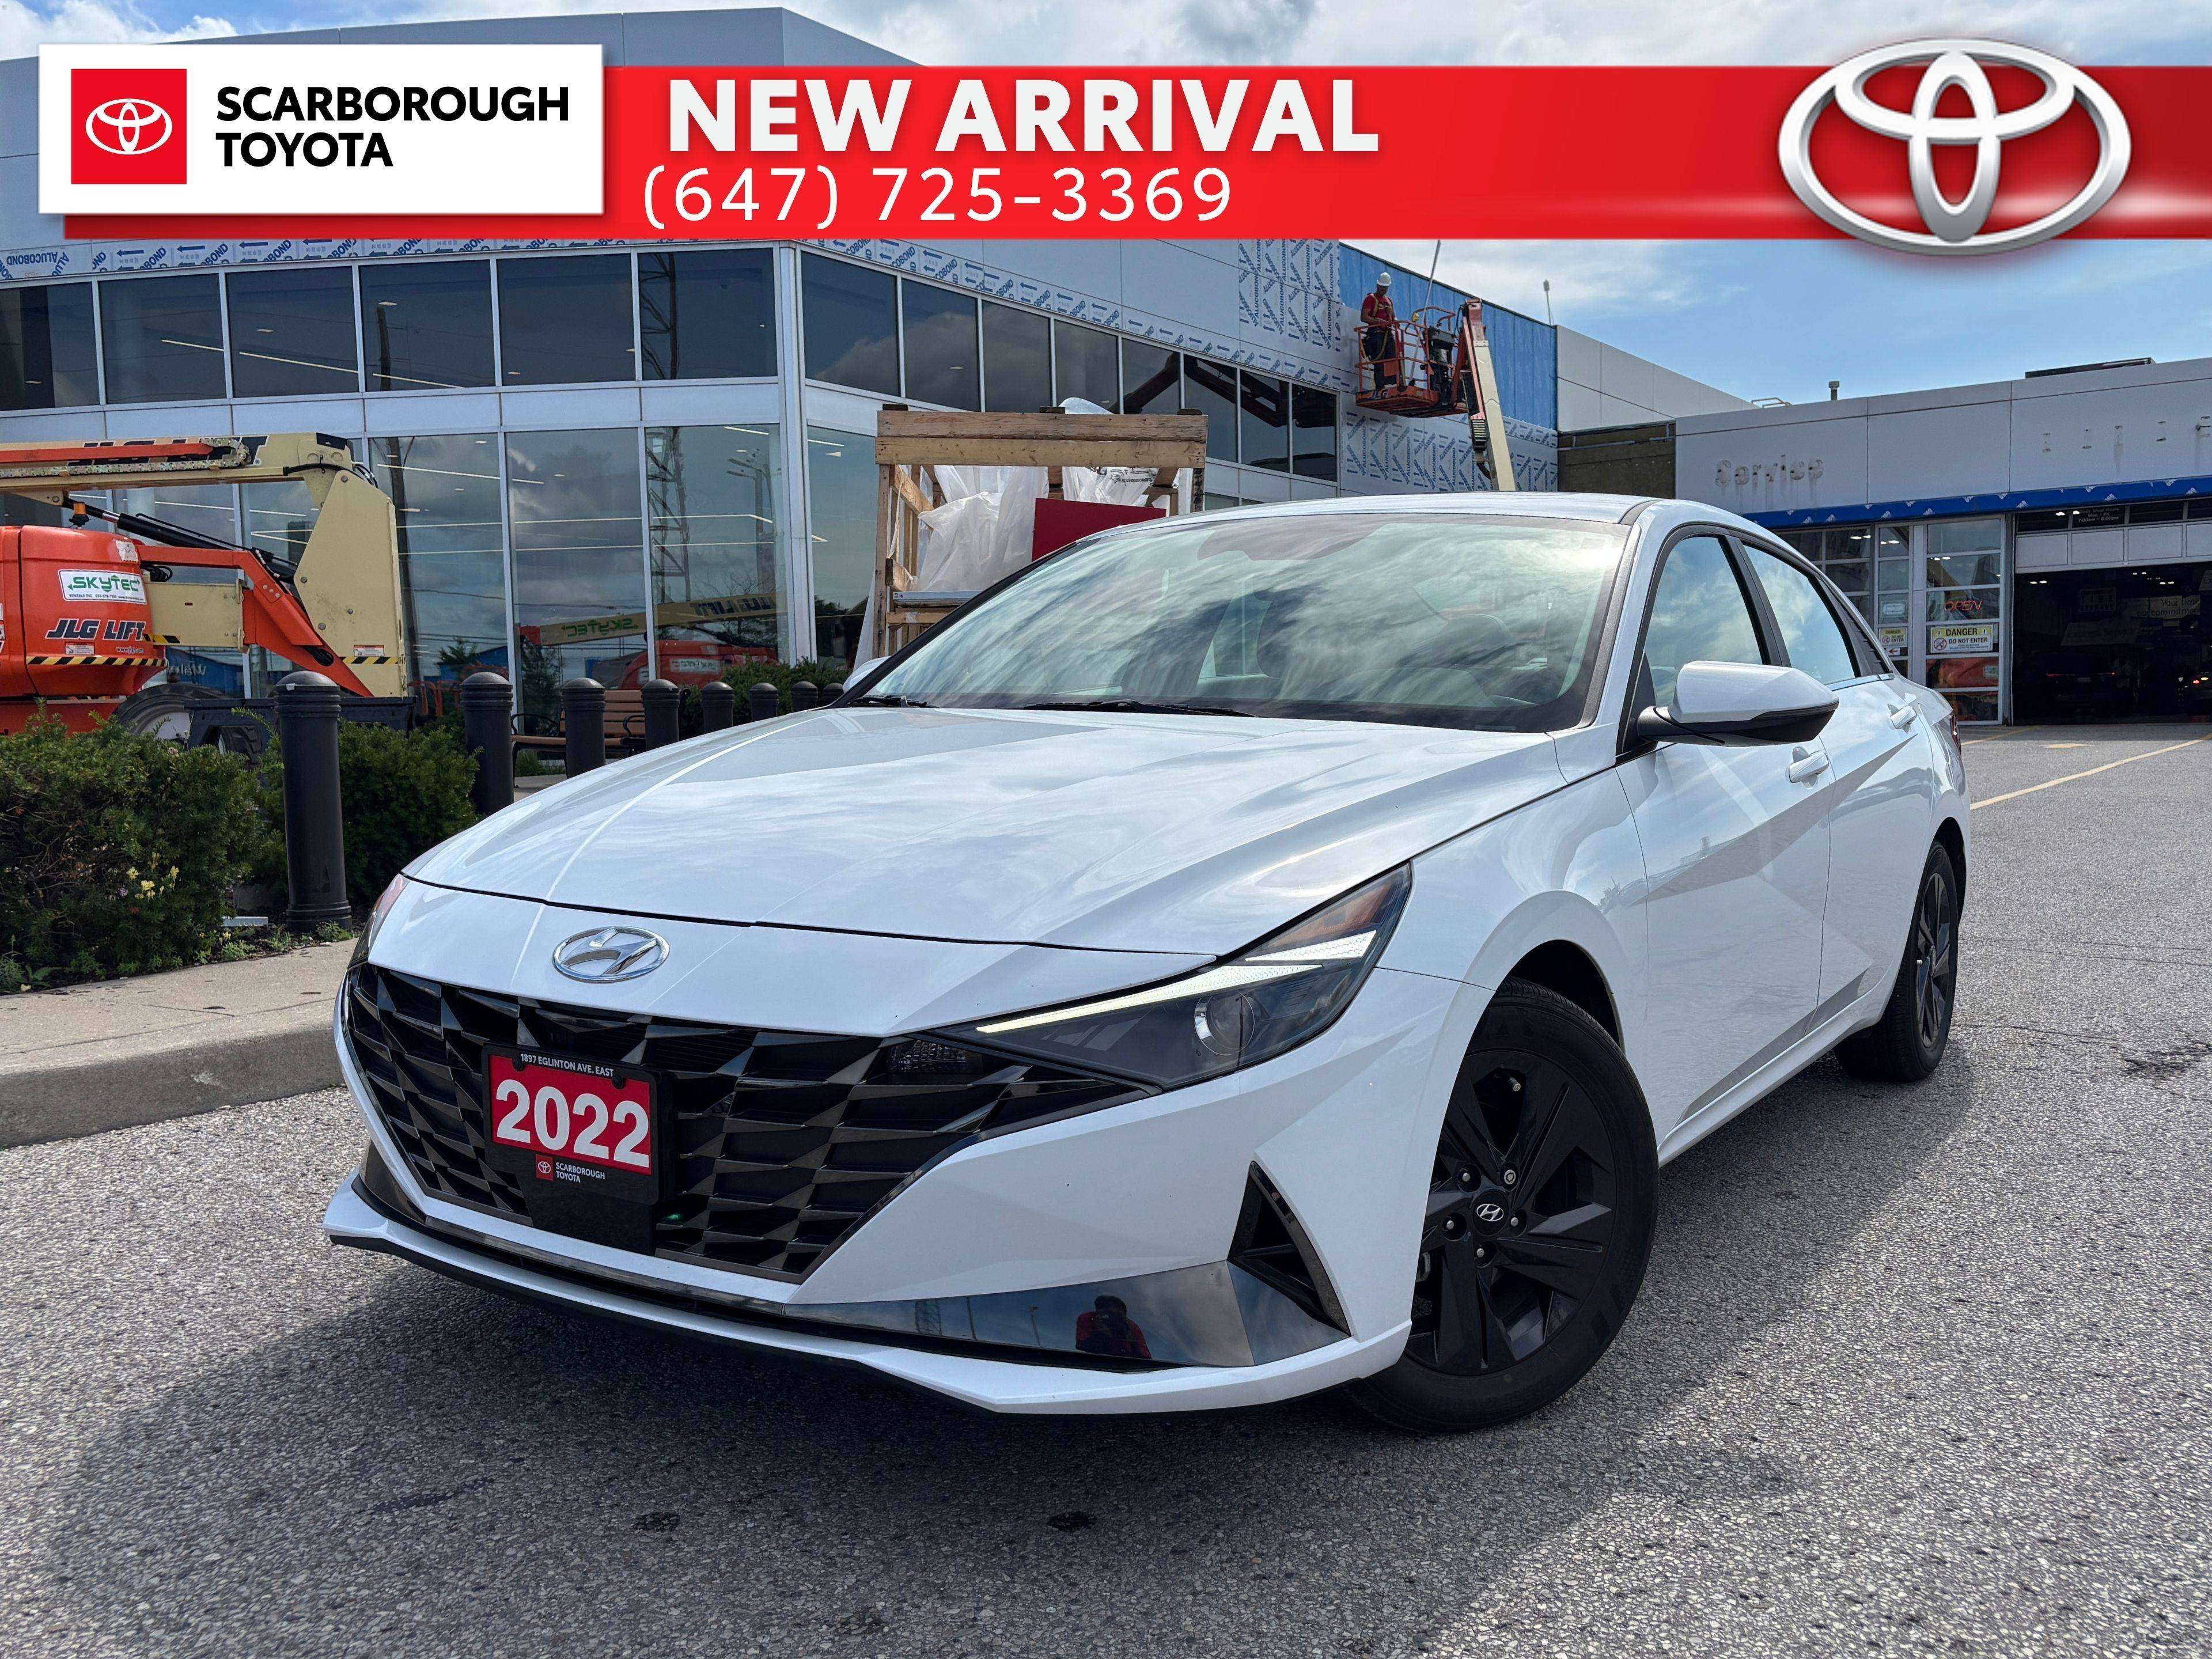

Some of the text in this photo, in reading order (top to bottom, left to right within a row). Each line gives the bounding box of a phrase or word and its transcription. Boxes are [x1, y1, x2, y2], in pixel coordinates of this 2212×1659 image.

[6, 252, 58, 266] ALUCOBOND
[70, 575, 139, 592] SKYTEC
[1944, 600, 1982, 612] OPEN
[45, 618, 146, 641] JLG LIFT
[1946, 628, 1978, 636] DANGER
[520, 1053, 614, 1077] 1897 EGLINTON AVE. EAST
[496, 1079, 649, 1168] 2022
[555, 1162, 605, 1180] SCARBOROUGH
[556, 1171, 581, 1183] TOYOTA
